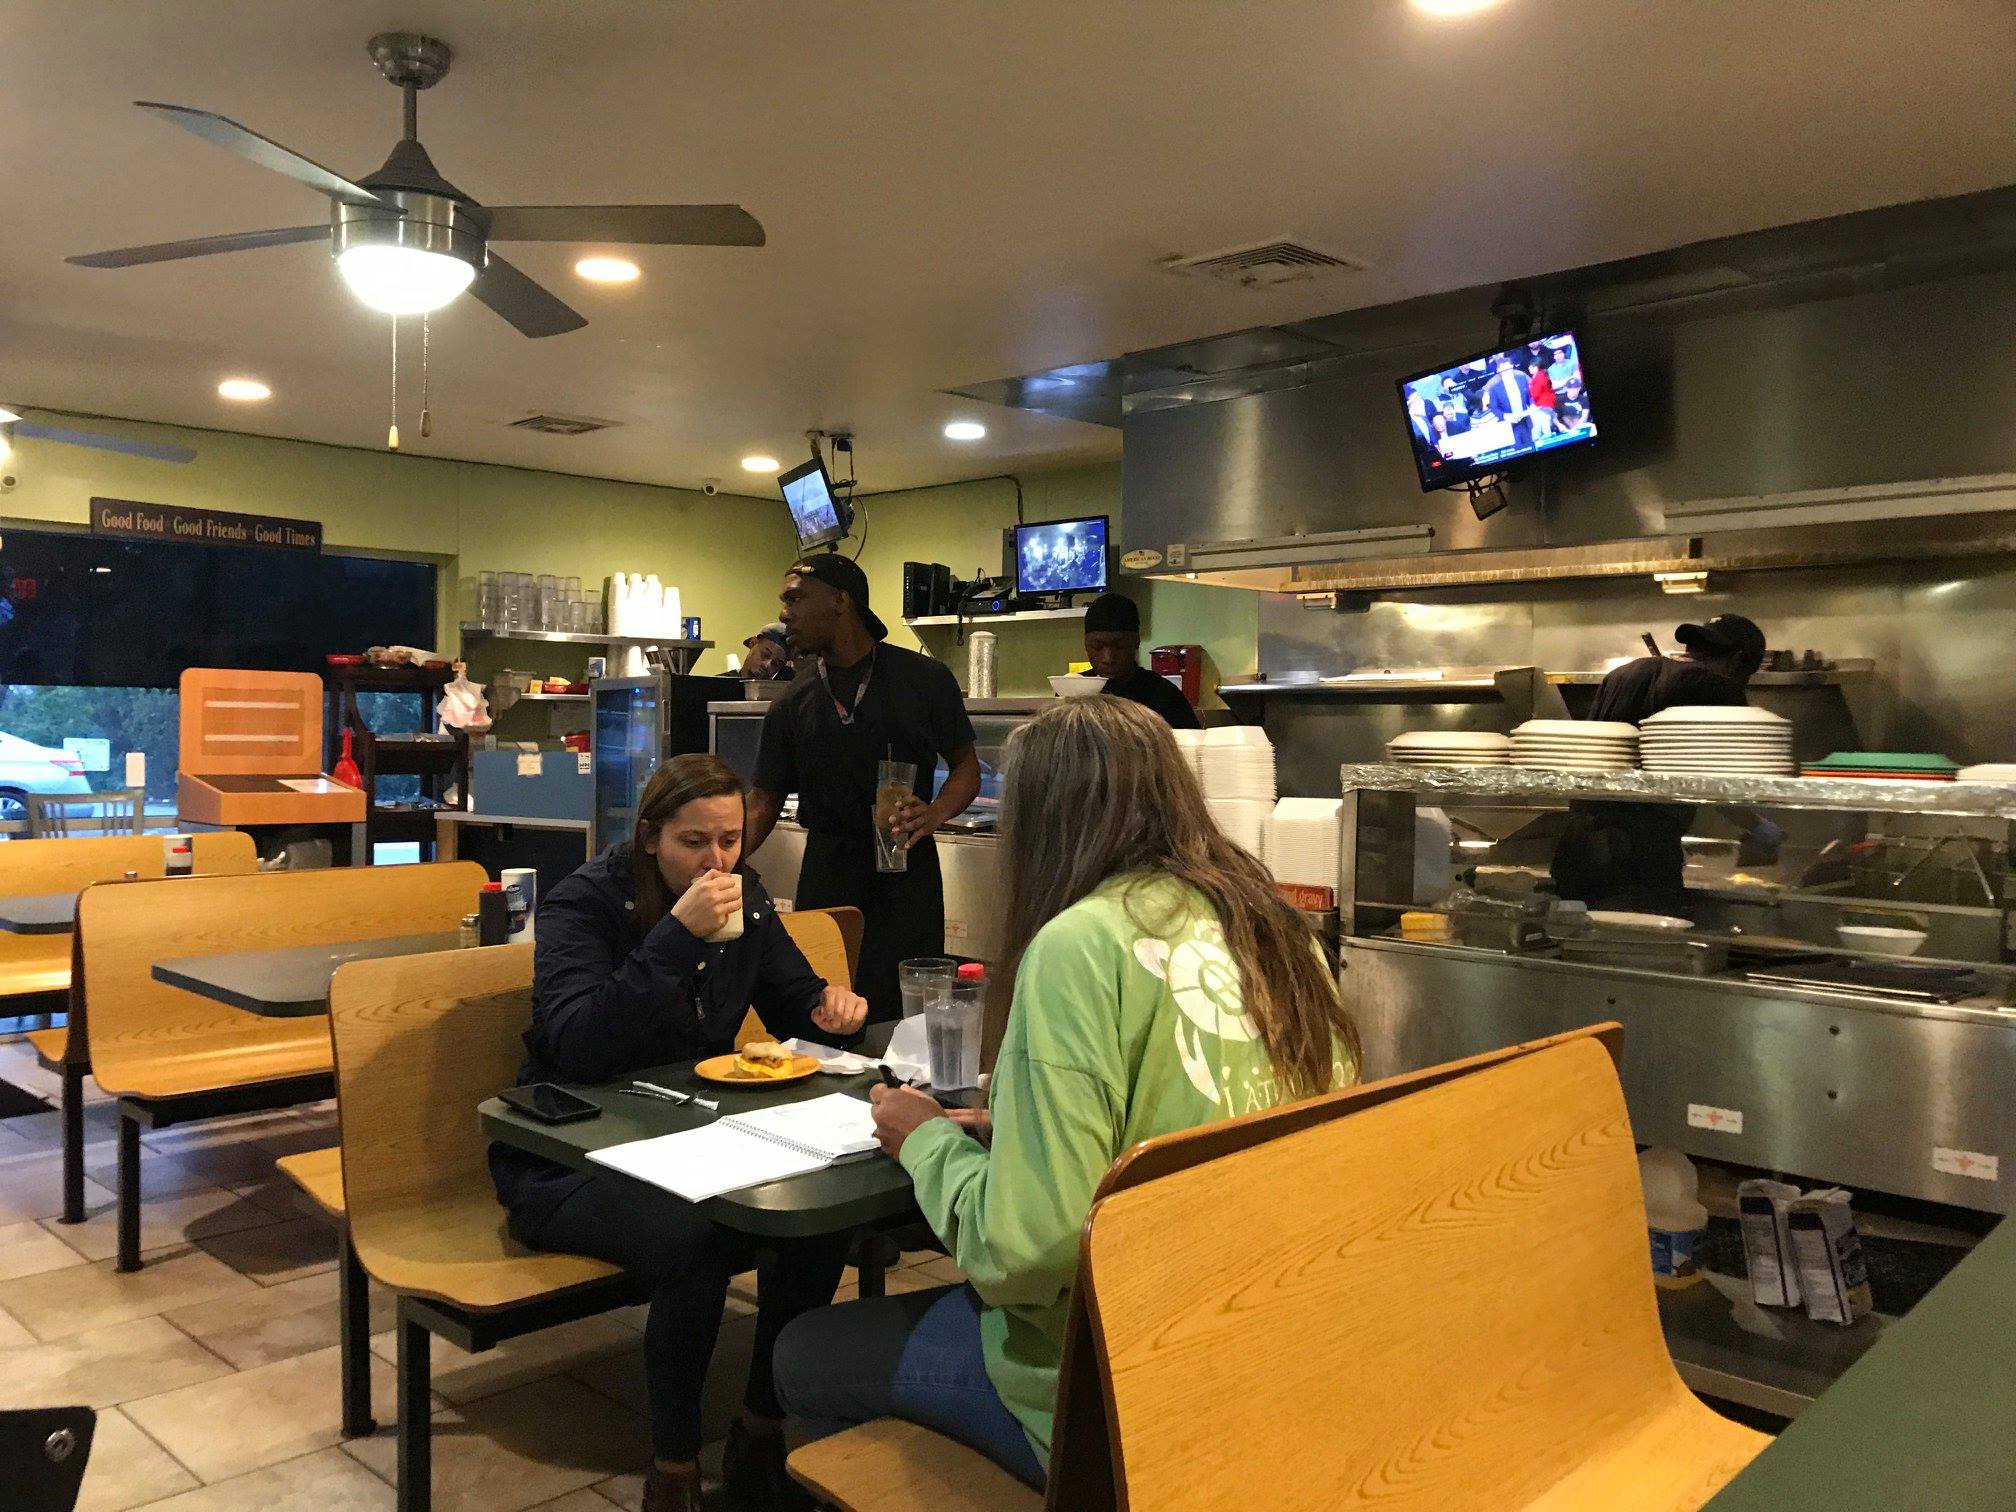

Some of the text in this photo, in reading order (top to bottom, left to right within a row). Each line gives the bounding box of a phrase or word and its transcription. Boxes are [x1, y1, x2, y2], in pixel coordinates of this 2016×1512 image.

[101, 508, 316, 547] Good Food Good Friends Good Times
